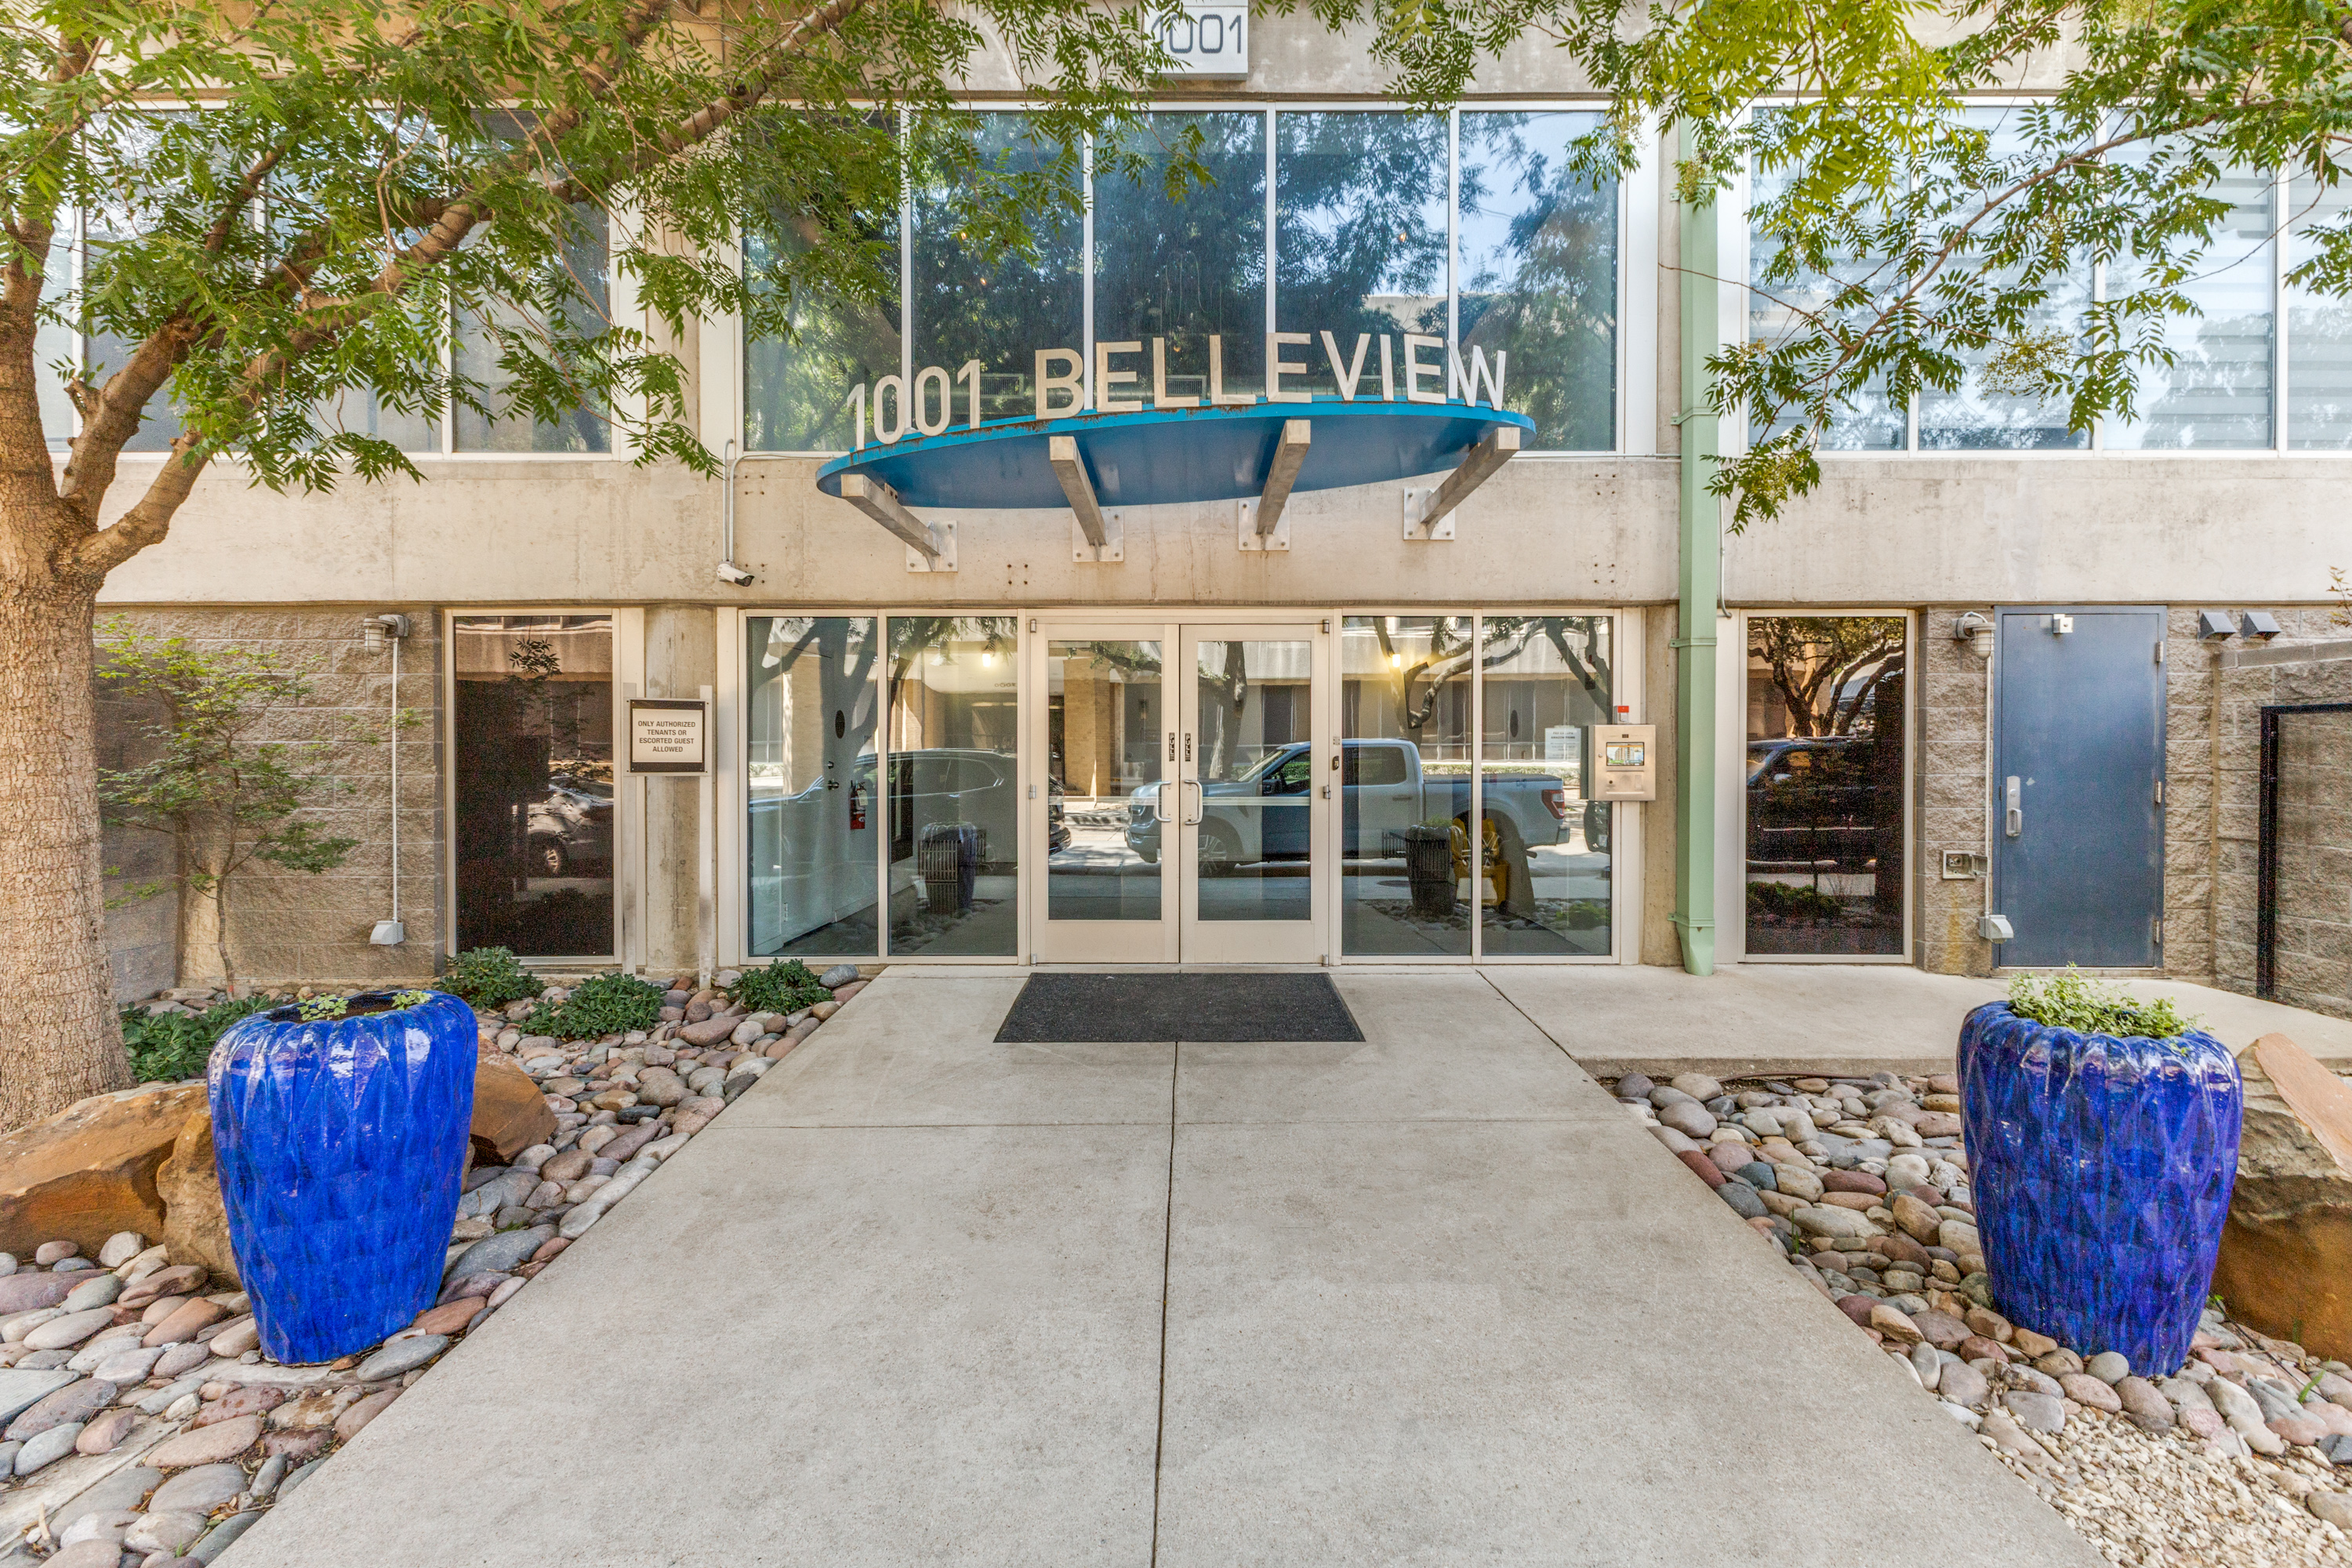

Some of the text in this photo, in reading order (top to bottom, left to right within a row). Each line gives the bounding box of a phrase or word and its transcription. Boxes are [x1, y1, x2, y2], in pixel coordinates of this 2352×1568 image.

[1152, 14, 1241, 54] 1001
[847, 330, 1506, 451] 1001 BELLEVIEW
